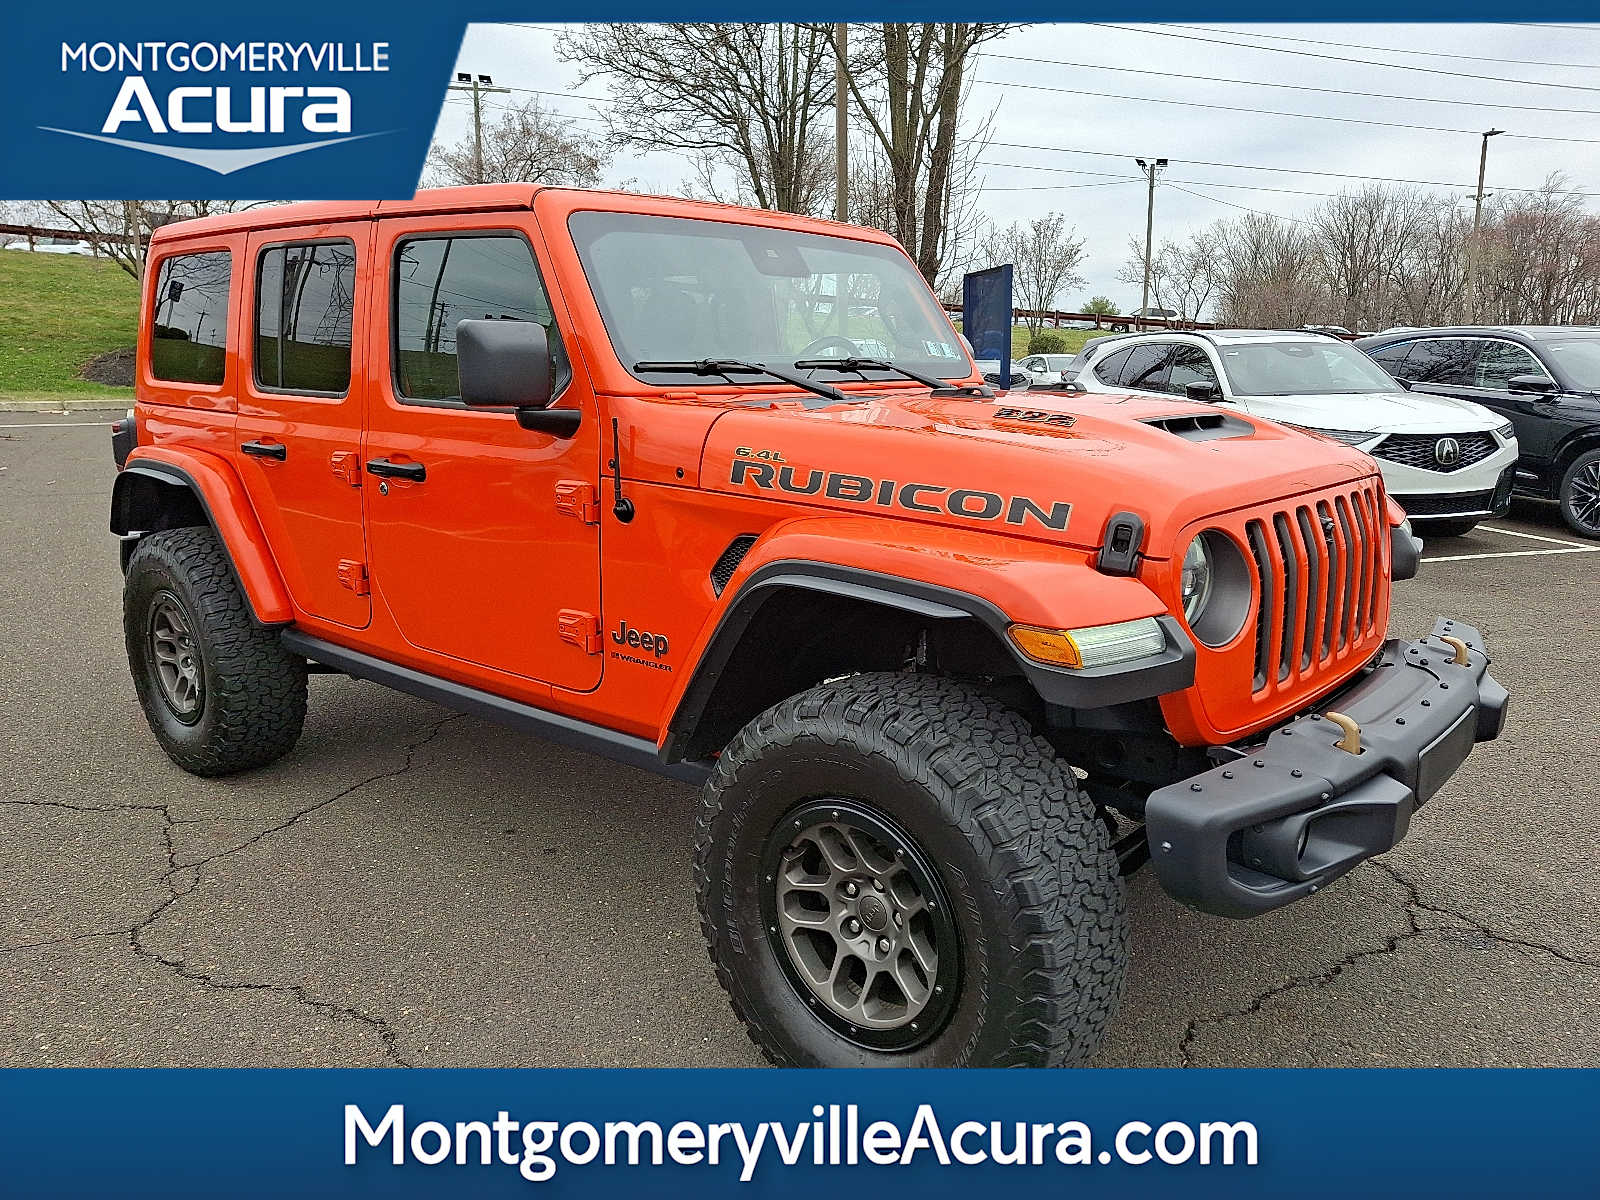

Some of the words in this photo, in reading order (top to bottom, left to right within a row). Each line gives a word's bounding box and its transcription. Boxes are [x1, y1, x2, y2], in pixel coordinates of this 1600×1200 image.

[735, 446, 786, 463] 6.4L
[729, 459, 1074, 532] RUBICON
[611, 620, 670, 659] Jeep
[619, 653, 673, 673] WRANGLER
